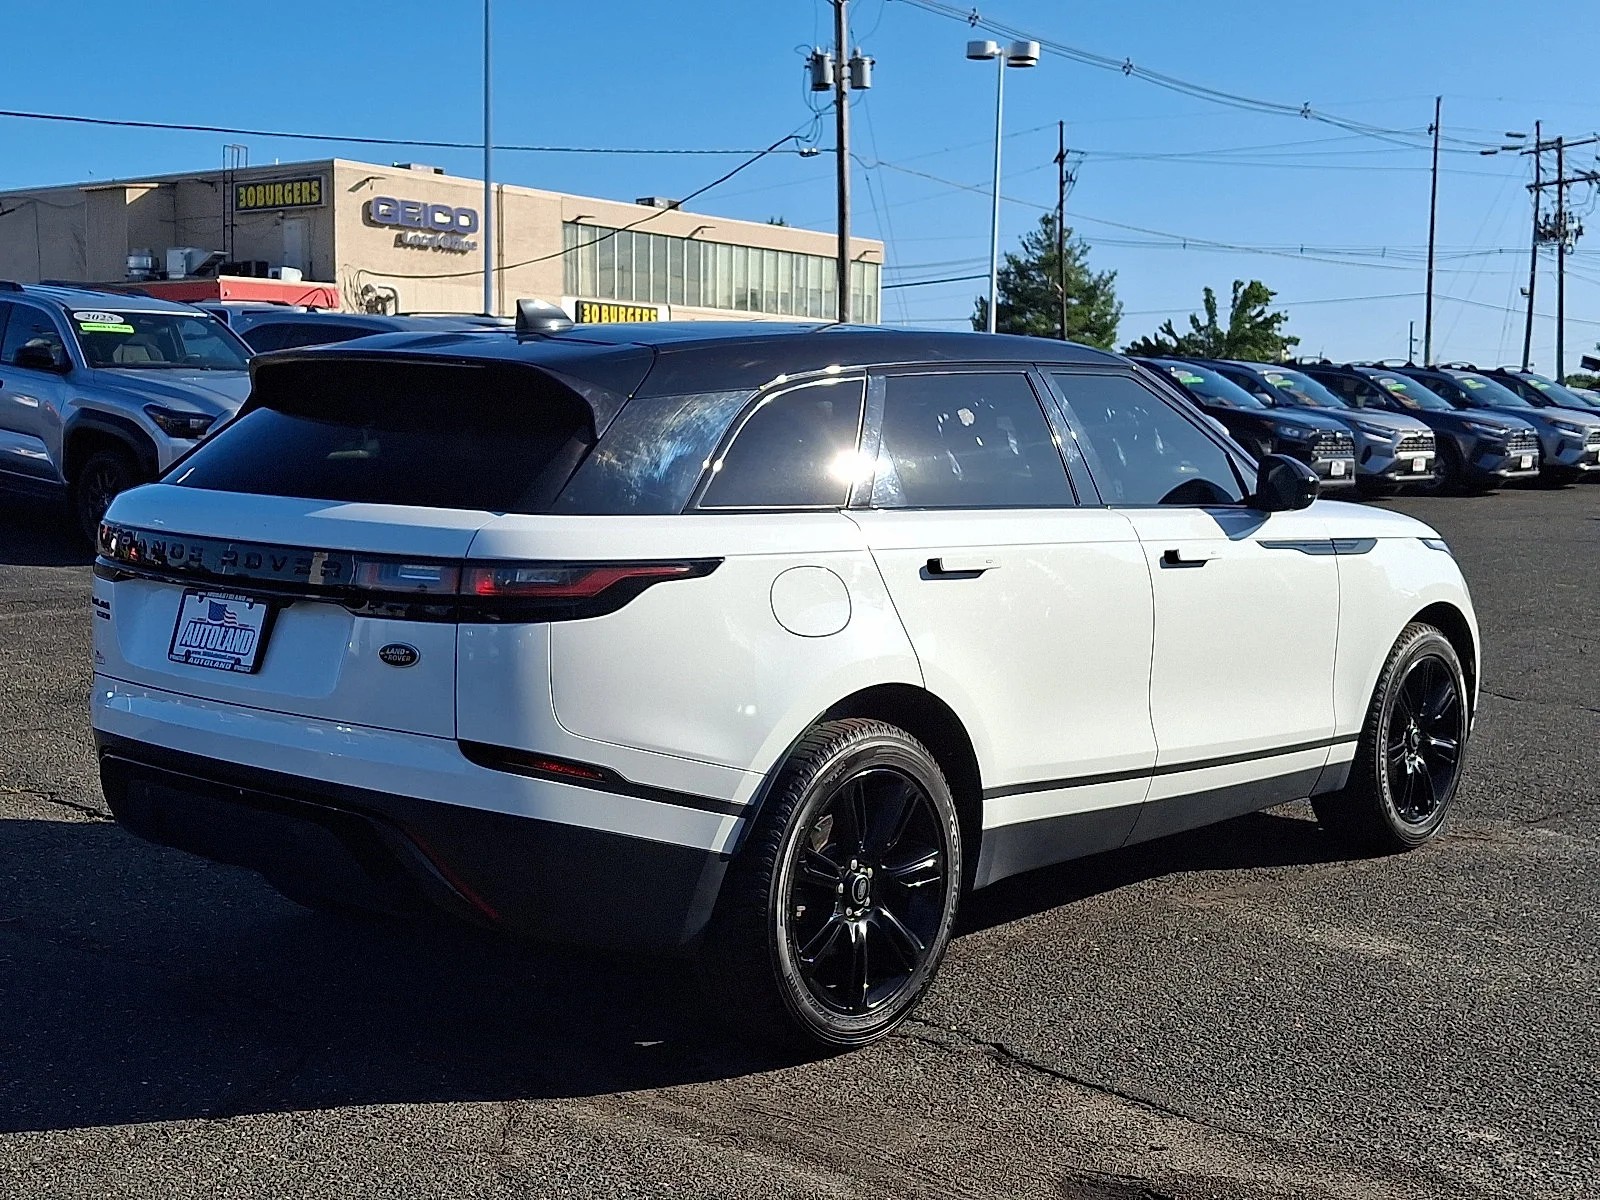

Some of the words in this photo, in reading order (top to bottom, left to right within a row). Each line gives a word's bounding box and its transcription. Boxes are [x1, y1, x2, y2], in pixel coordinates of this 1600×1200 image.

[373, 196, 479, 234] GEICO
[221, 550, 342, 578] ROVER
[181, 622, 255, 654] AUTOLAND
[385, 647, 406, 655] LAND
[387, 654, 412, 662] ROVER
[188, 657, 232, 670] AUTOLAND
